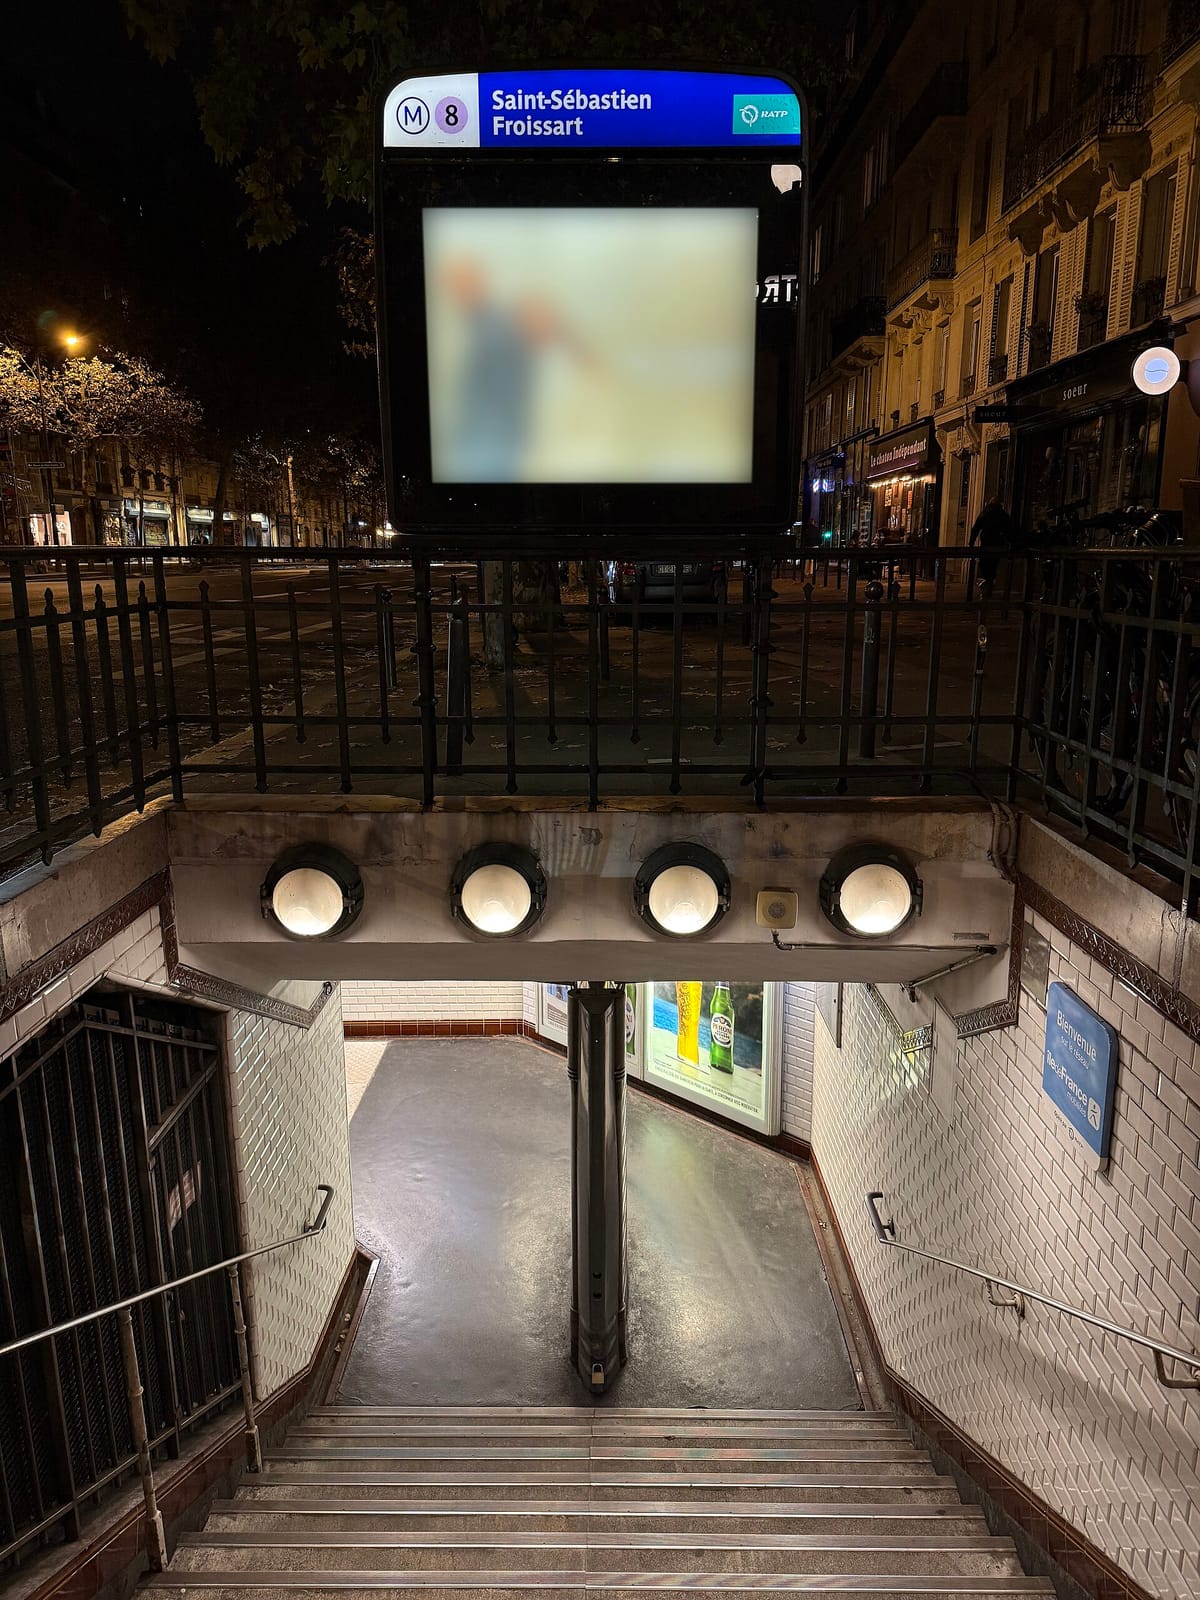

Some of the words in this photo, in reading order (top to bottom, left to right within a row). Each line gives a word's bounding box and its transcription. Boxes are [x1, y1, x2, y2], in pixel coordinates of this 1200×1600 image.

[492, 89, 652, 110] Saint-Sébastien
[404, 105, 422, 126] M
[445, 104, 458, 126] 8
[492, 116, 584, 136] Froissart
[1062, 383, 1088, 401] soeur
[870, 455, 877, 468] Le
[893, 437, 927, 461] Indépendant
[1057, 1009, 1097, 1061] Bienvenue
